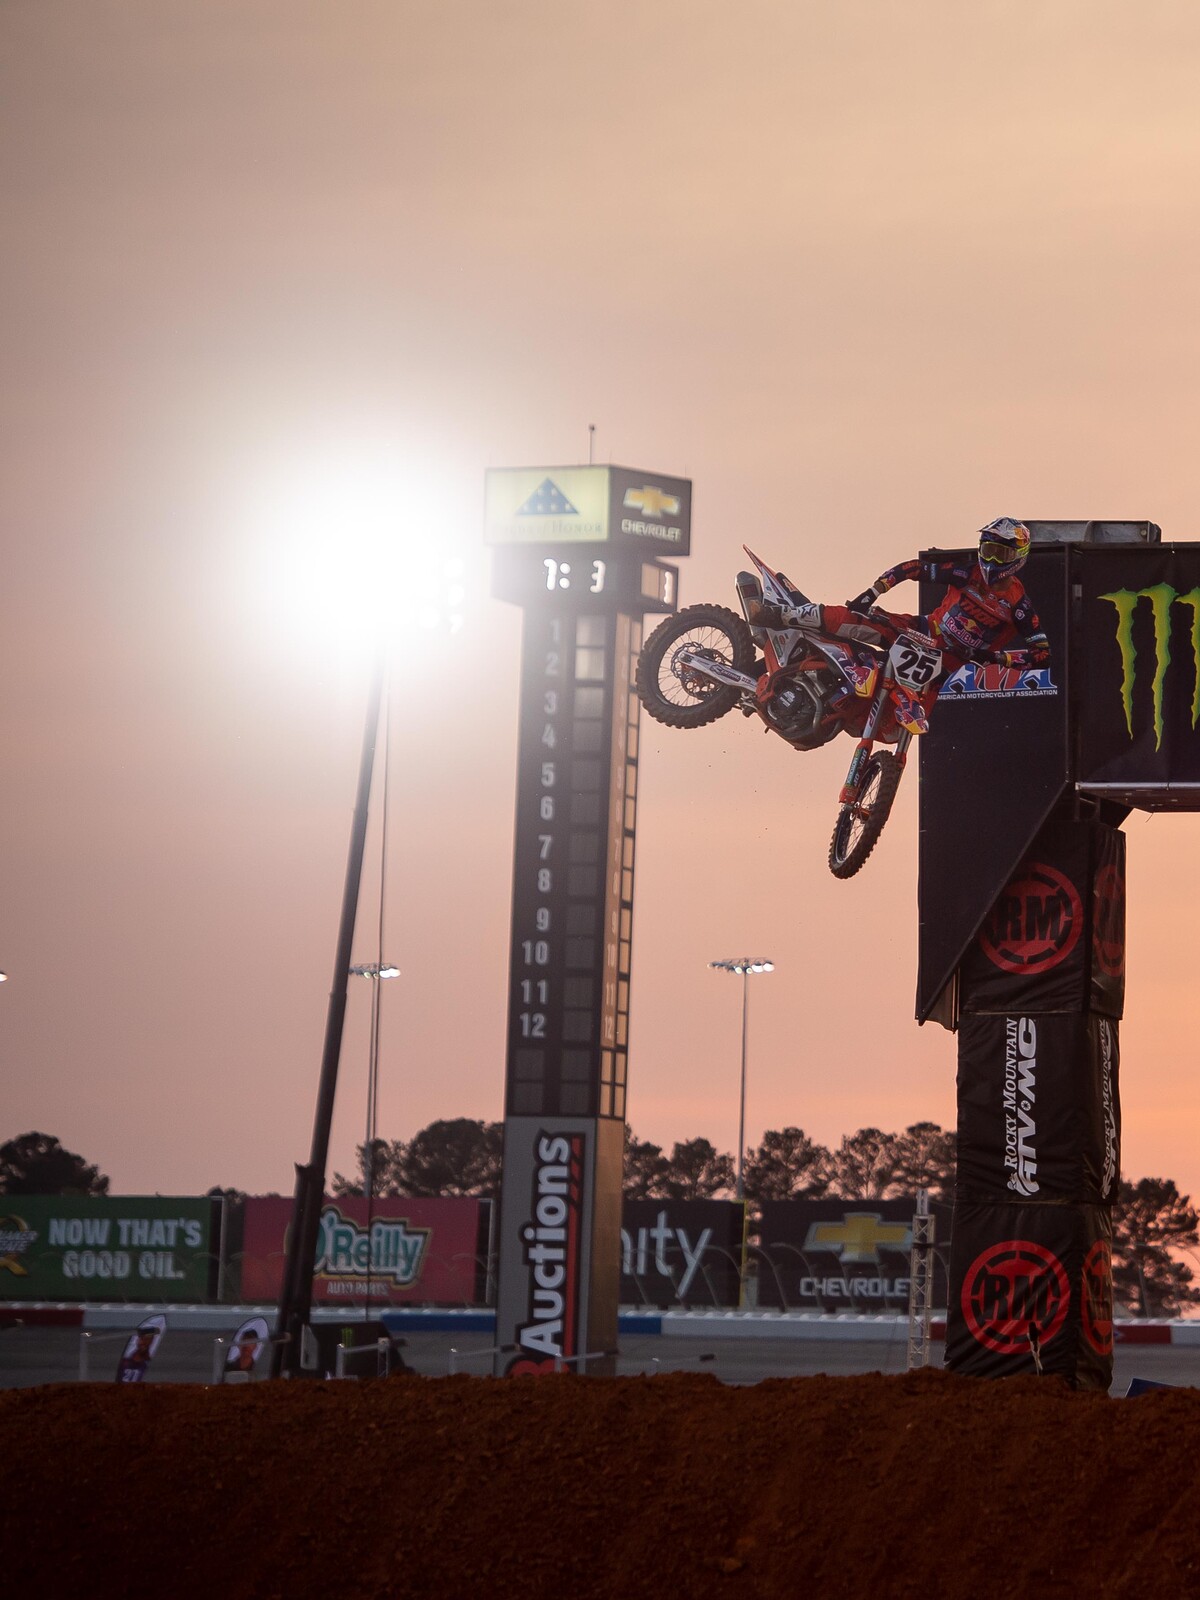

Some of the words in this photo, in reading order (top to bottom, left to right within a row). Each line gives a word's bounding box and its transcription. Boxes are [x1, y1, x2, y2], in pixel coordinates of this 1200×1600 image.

[621, 518, 682, 542] CHEVROLET
[896, 650, 938, 685] 25
[938, 663, 1058, 693] AMA
[544, 690, 557, 714] 3
[936, 693, 966, 701] MERICAN
[541, 723, 556, 749] 4
[541, 762, 555, 787] 5
[540, 796, 553, 820] 6
[538, 835, 552, 860] 7
[537, 868, 551, 892] 8
[536, 907, 549, 932] 9
[522, 940, 548, 965] 10
[521, 979, 547, 1003] 11
[519, 1012, 545, 1038] 12
[1003, 1017, 1018, 1112] MOUNTAIN
[1004, 1115, 1018, 1170] ROCKY
[48, 1217, 110, 1246] NOW
[117, 1217, 202, 1247] THAT'S
[520, 1136, 570, 1358] Auctions
[62, 1250, 130, 1278] GOOD
[139, 1251, 185, 1279] OIL.
[327, 1281, 353, 1294] AUTO
[355, 1282, 388, 1295] PARTS
[800, 1277, 912, 1297] CHEVROLE
